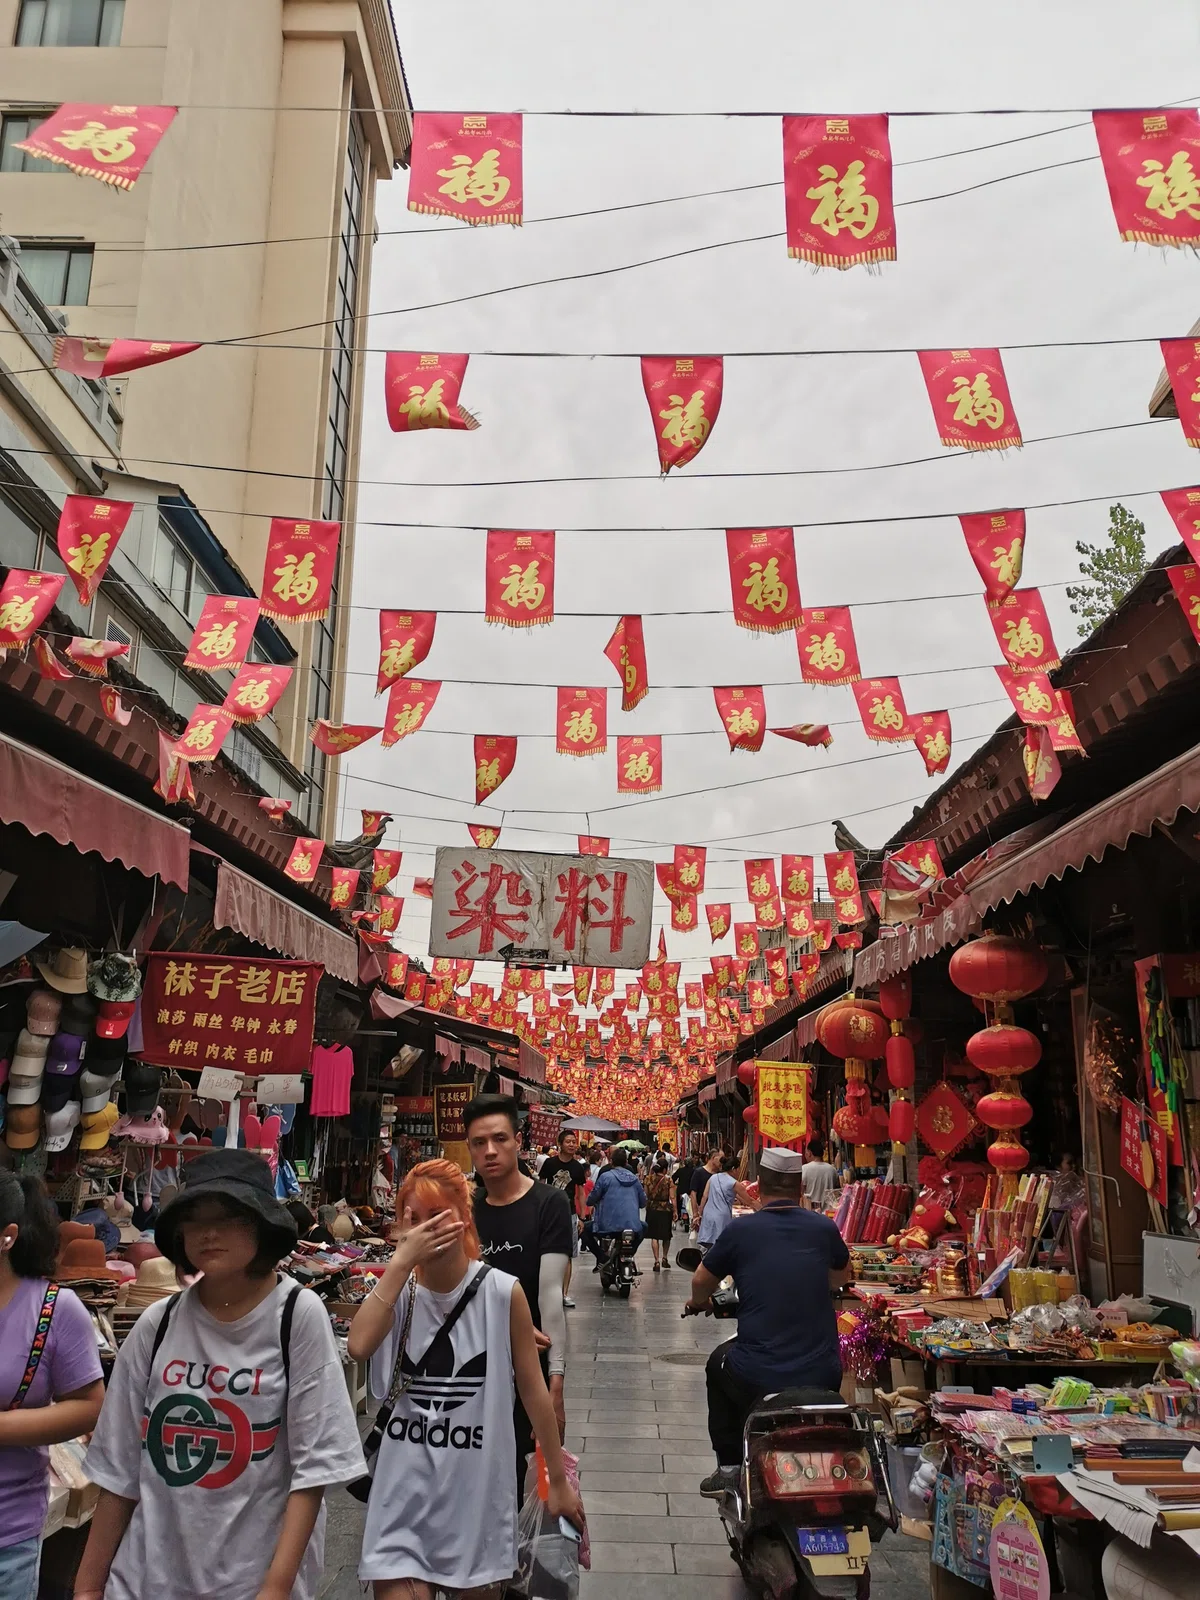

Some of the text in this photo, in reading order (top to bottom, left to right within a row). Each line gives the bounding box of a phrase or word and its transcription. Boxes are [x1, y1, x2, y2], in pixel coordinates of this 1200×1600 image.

[53, 121, 139, 163] 福
[437, 149, 510, 207] 福
[1137, 150, 1200, 221] 福
[806, 160, 880, 239] 福
[947, 373, 1005, 429] 福
[660, 388, 710, 448] 福
[273, 551, 318, 605] 福
[500, 561, 545, 610] 福
[743, 556, 788, 613] 福
[0, 595, 37, 632] 福
[198, 621, 238, 659] 福
[805, 631, 846, 672] 福
[1002, 624, 1043, 658] 福
[380, 638, 417, 678] 福
[235, 680, 269, 709] 福
[1016, 682, 1052, 713] 福
[564, 708, 597, 744] 福
[727, 708, 759, 736] 福
[869, 696, 903, 730] 福
[185, 721, 216, 751] 福
[924, 730, 952, 763] 福
[475, 758, 503, 792] 福
[625, 752, 654, 783] 福
[292, 854, 311, 875] 福
[373, 865, 391, 887] 福
[679, 862, 700, 887] 福
[833, 866, 855, 891] 福
[332, 882, 349, 902] 福
[751, 874, 770, 896] 福
[788, 870, 809, 895] 福
[378, 908, 394, 927] 福
[446, 860, 635, 954] 染料
[759, 903, 776, 921] 福
[791, 908, 809, 931] 福
[839, 898, 857, 916] 福
[711, 915, 726, 935] 福
[740, 933, 756, 953] 福
[163, 960, 307, 1005] 袜子老店
[157, 1008, 298, 1035] 浪莎 雨丝 华钟 永春
[168, 1038, 274, 1065] 针织 内衣 毛巾
[263, 1075, 294, 1097] 口罩
[763, 1081, 802, 1094] 批发零售
[763, 1098, 802, 1111] 笔墨纸砚
[41, 1291, 58, 1316] LOVE
[33, 1317, 50, 1349] LOVE
[23, 1350, 42, 1385] LOVE
[162, 1359, 264, 1396] GUCCI
[386, 1414, 484, 1450] adidas
